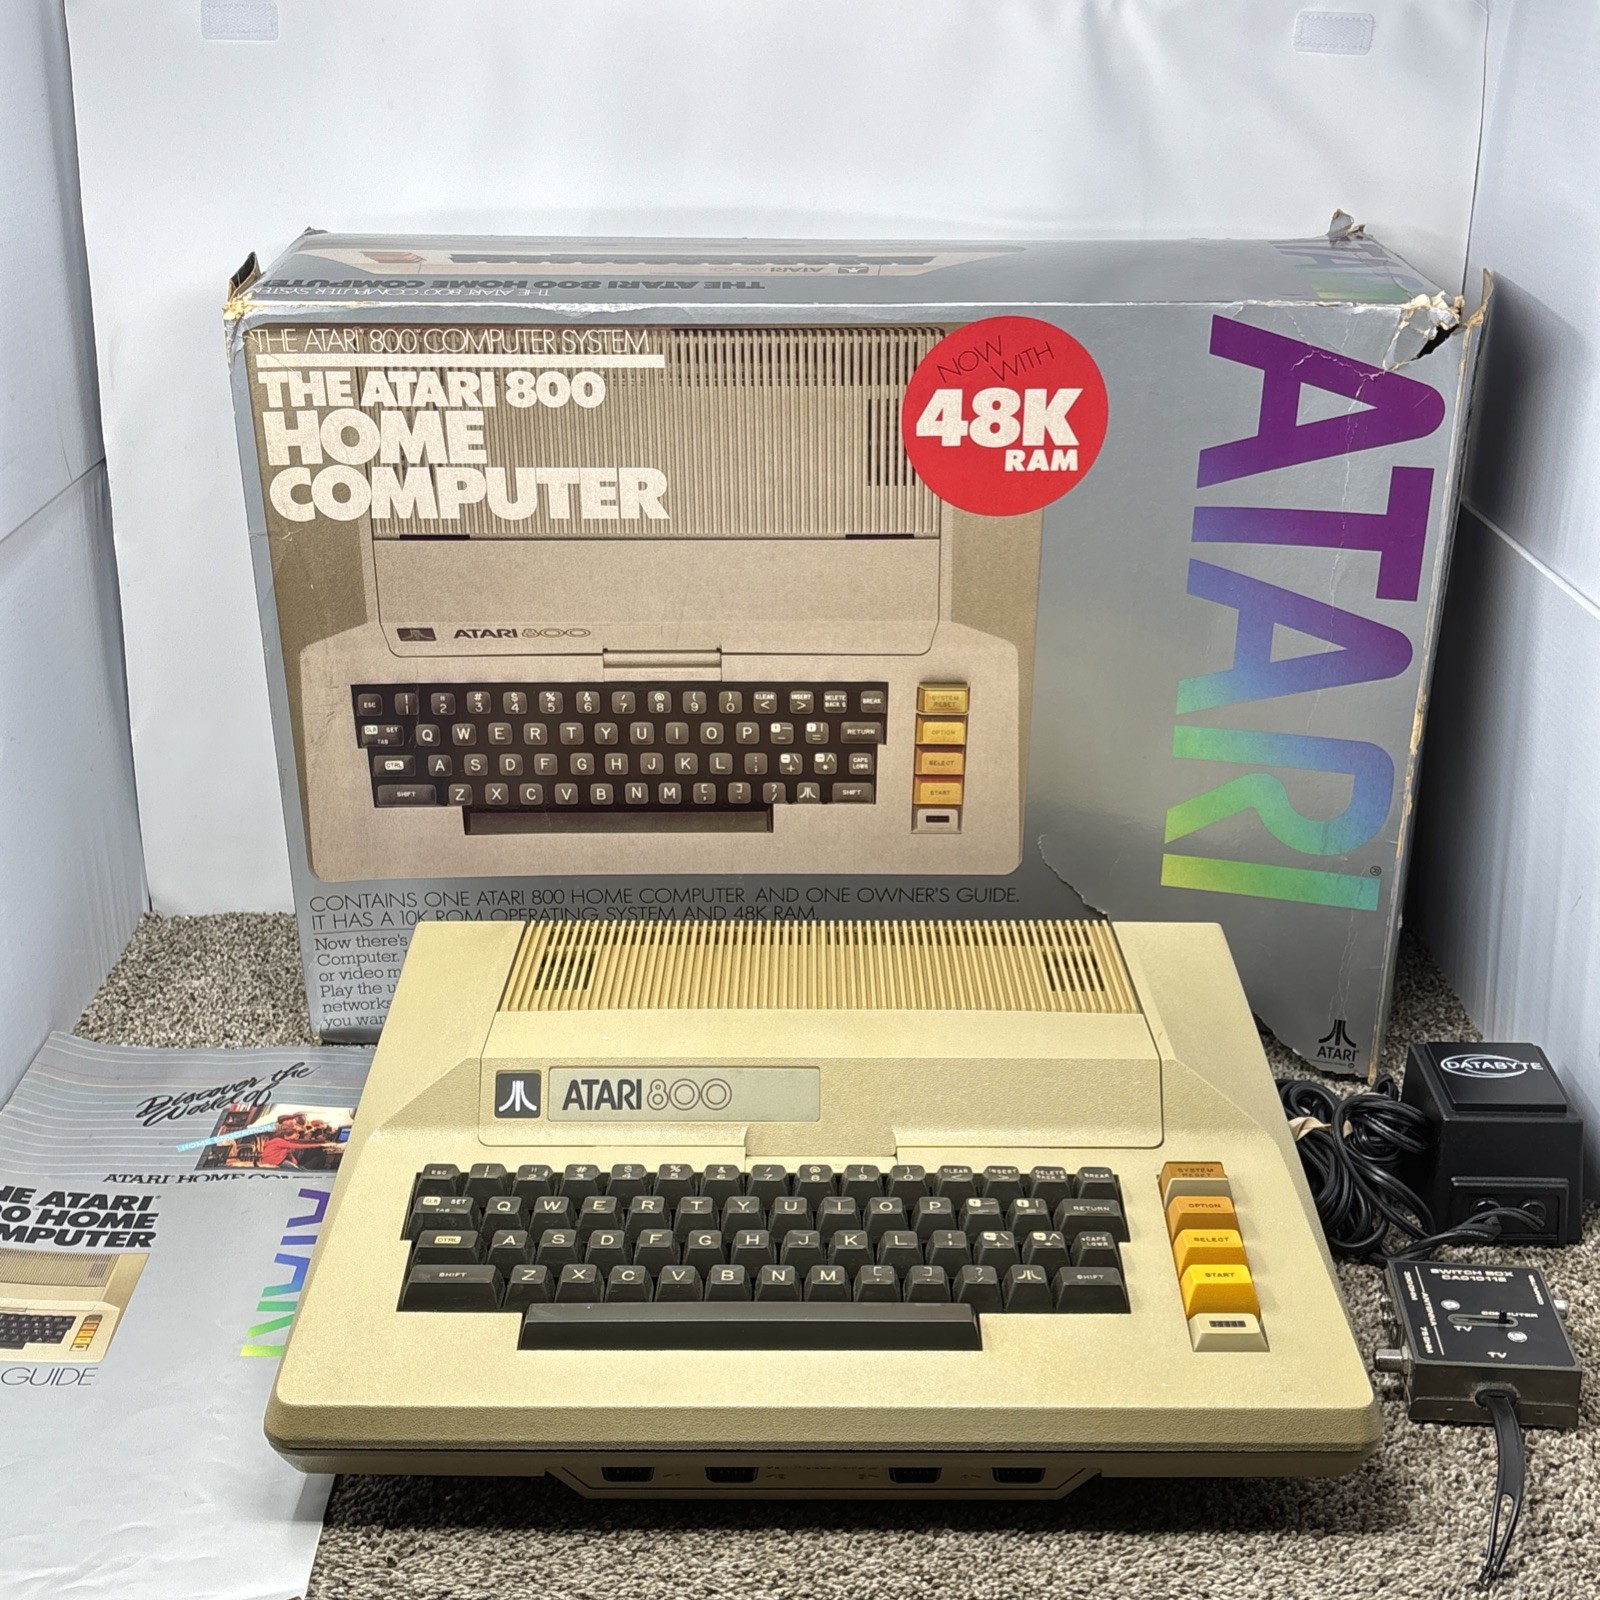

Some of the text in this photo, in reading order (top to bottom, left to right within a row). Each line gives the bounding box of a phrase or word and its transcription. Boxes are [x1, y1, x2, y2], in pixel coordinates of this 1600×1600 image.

[263, 280, 765, 289] THE ATARI 800 HOME COMPUTE
[252, 328, 649, 353] THE ATARI 800 COMPUTER SYSTEM
[936, 334, 1004, 383] NOW
[989, 341, 1054, 382] WITH
[258, 370, 606, 409] THE ATARI 800
[916, 387, 1083, 448] 48K
[262, 408, 487, 466] HOME
[1004, 449, 1078, 472] RAM
[269, 465, 670, 522] COMPUTER
[1160, 313, 1446, 912] ATARI
[454, 628, 591, 638] ATARI 800
[309, 887, 1020, 912] CONTAINS ONE ATARI 800 HOME COMPUTER AND ONE OWNER'S GUIDE.
[312, 914, 325, 931] IT
[333, 912, 374, 930] HAS
[380, 911, 394, 926] A
[400, 910, 428, 926] 10K
[683, 906, 727, 920] AND
[734, 906, 767, 920] 48K
[314, 934, 408, 951] Now there's
[319, 971, 334, 982] or
[339, 968, 384, 981] video
[320, 983, 354, 999] Play
[358, 982, 382, 994] the
[322, 998, 392, 1013] networks
[323, 1016, 352, 1031] you
[1317, 1046, 1356, 1062] ATARI
[1446, 1060, 1544, 1071] DATABYTE
[135, 1062, 321, 1119] Discover the
[562, 1078, 732, 1111] ATARI 800
[142, 1080, 281, 1127] World of
[103, 1174, 171, 1184] ATARI
[0, 1184, 154, 1212] HE ATARI
[35, 1208, 160, 1230] HOME
[0, 1222, 157, 1248] MPUTER
[1487, 1351, 1508, 1359] TV
[1, 1366, 98, 1386] GUIDE
